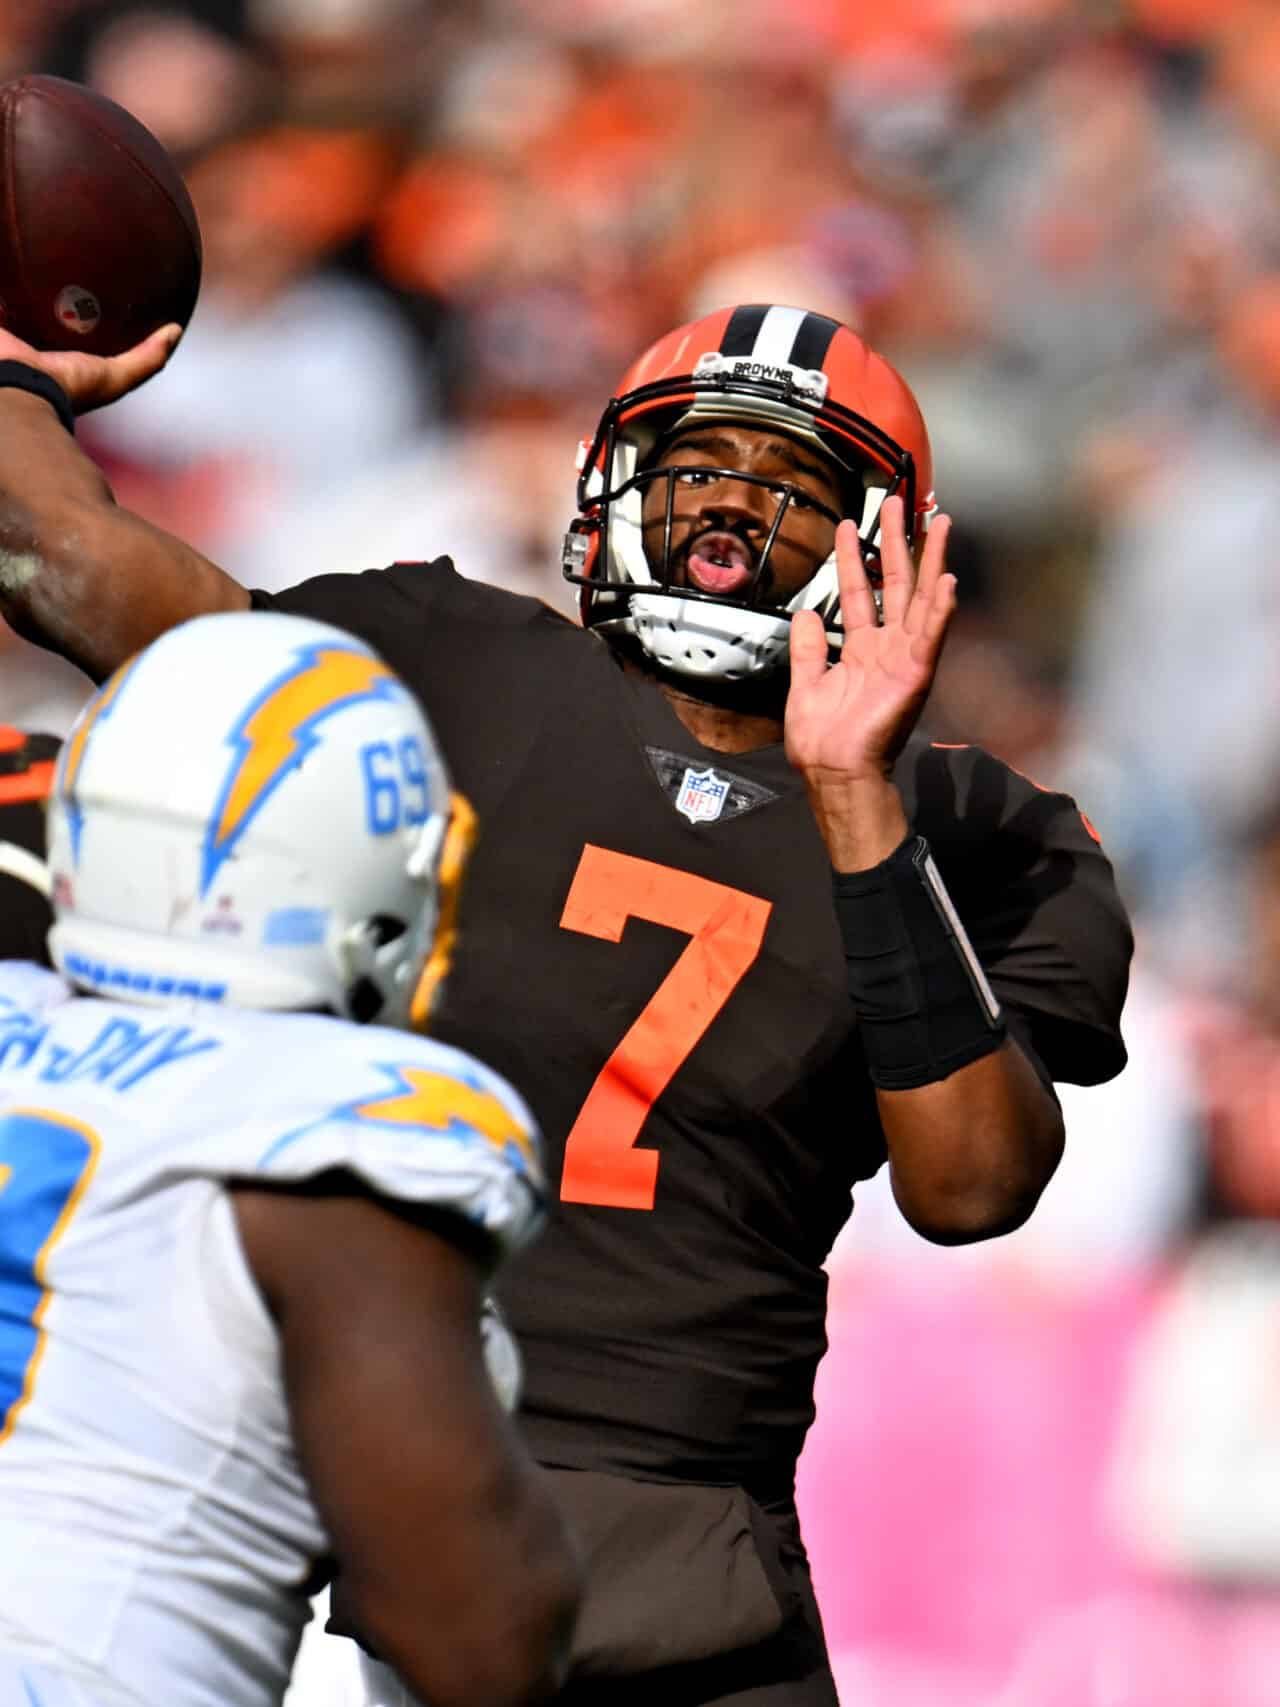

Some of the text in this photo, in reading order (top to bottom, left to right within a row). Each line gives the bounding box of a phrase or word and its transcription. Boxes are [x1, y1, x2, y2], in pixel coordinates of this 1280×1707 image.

[734, 361, 794, 382] BROWNS
[360, 736, 432, 837] 69
[684, 788, 719, 815] NFL
[559, 843, 773, 1211] 7
